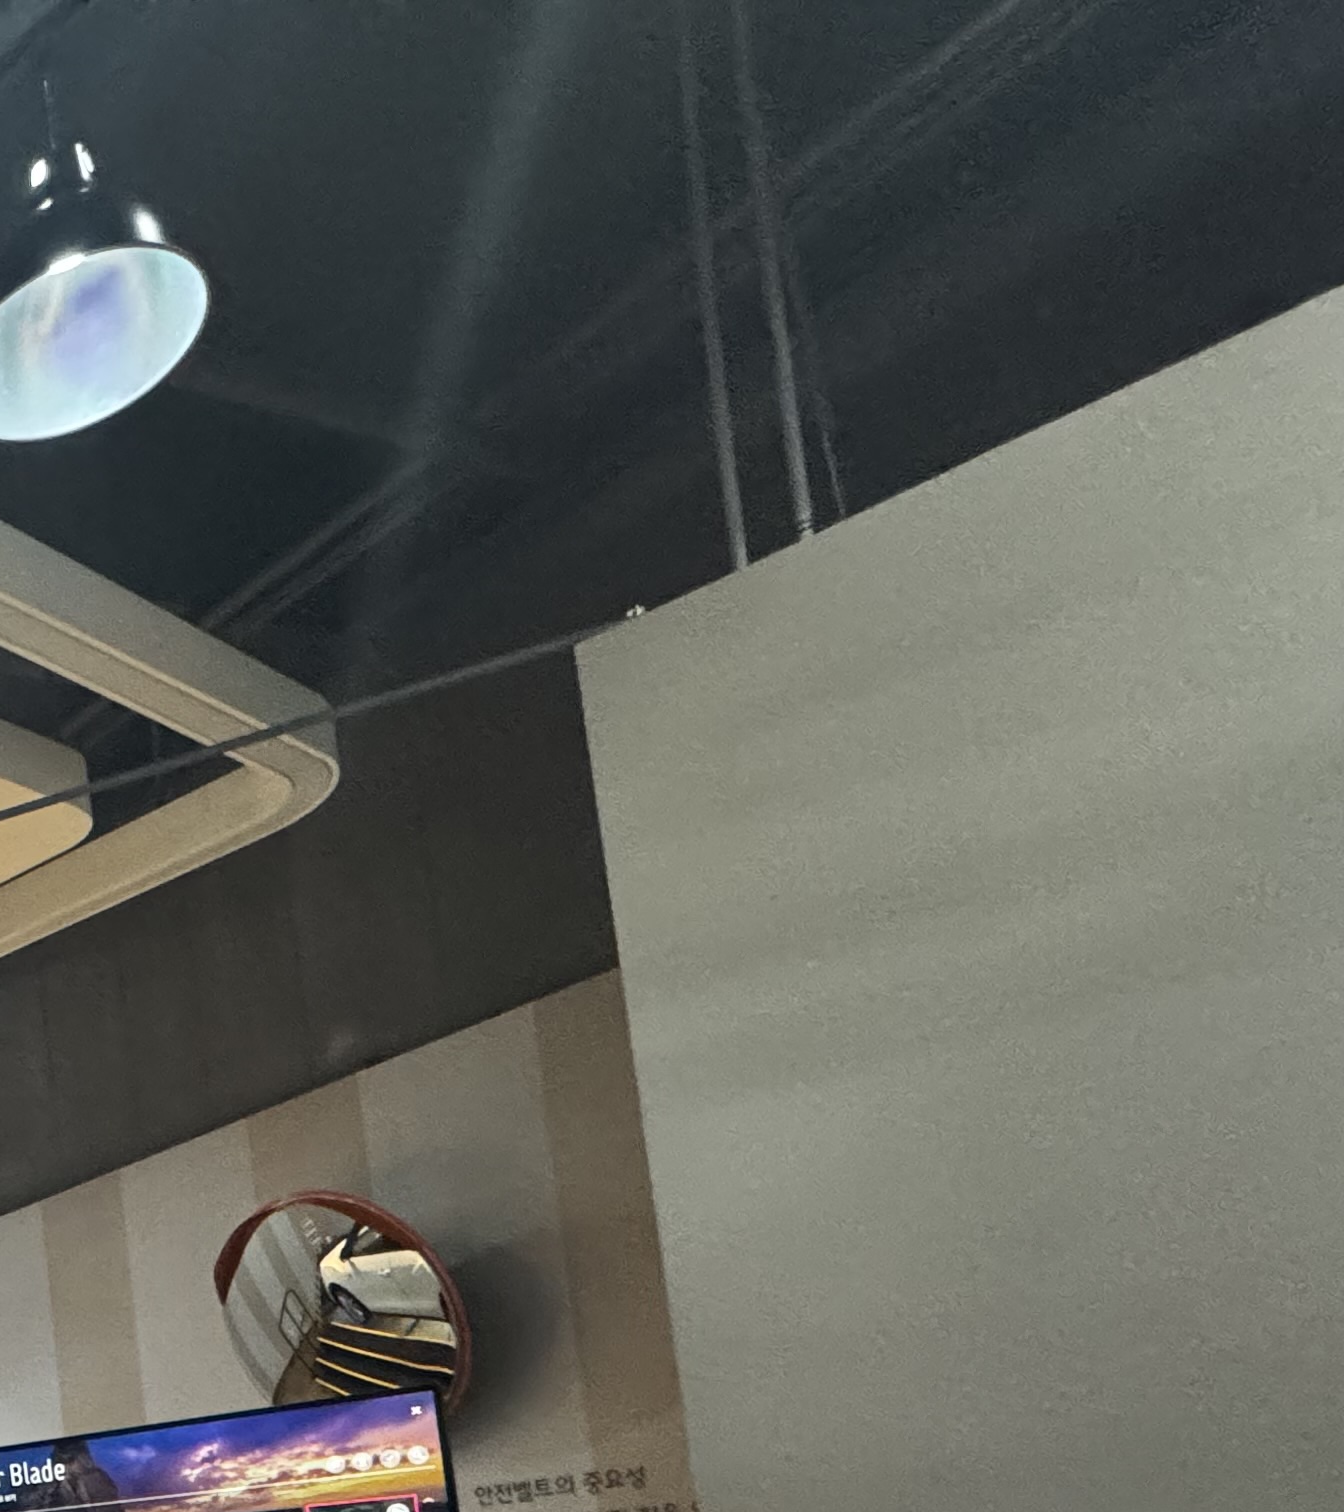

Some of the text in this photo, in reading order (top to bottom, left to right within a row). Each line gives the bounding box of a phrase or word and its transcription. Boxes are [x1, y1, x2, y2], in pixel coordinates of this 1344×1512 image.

[10, 1459, 66, 1487] Blade
[475, 1466, 647, 1506] 안전벨트의 중요성
